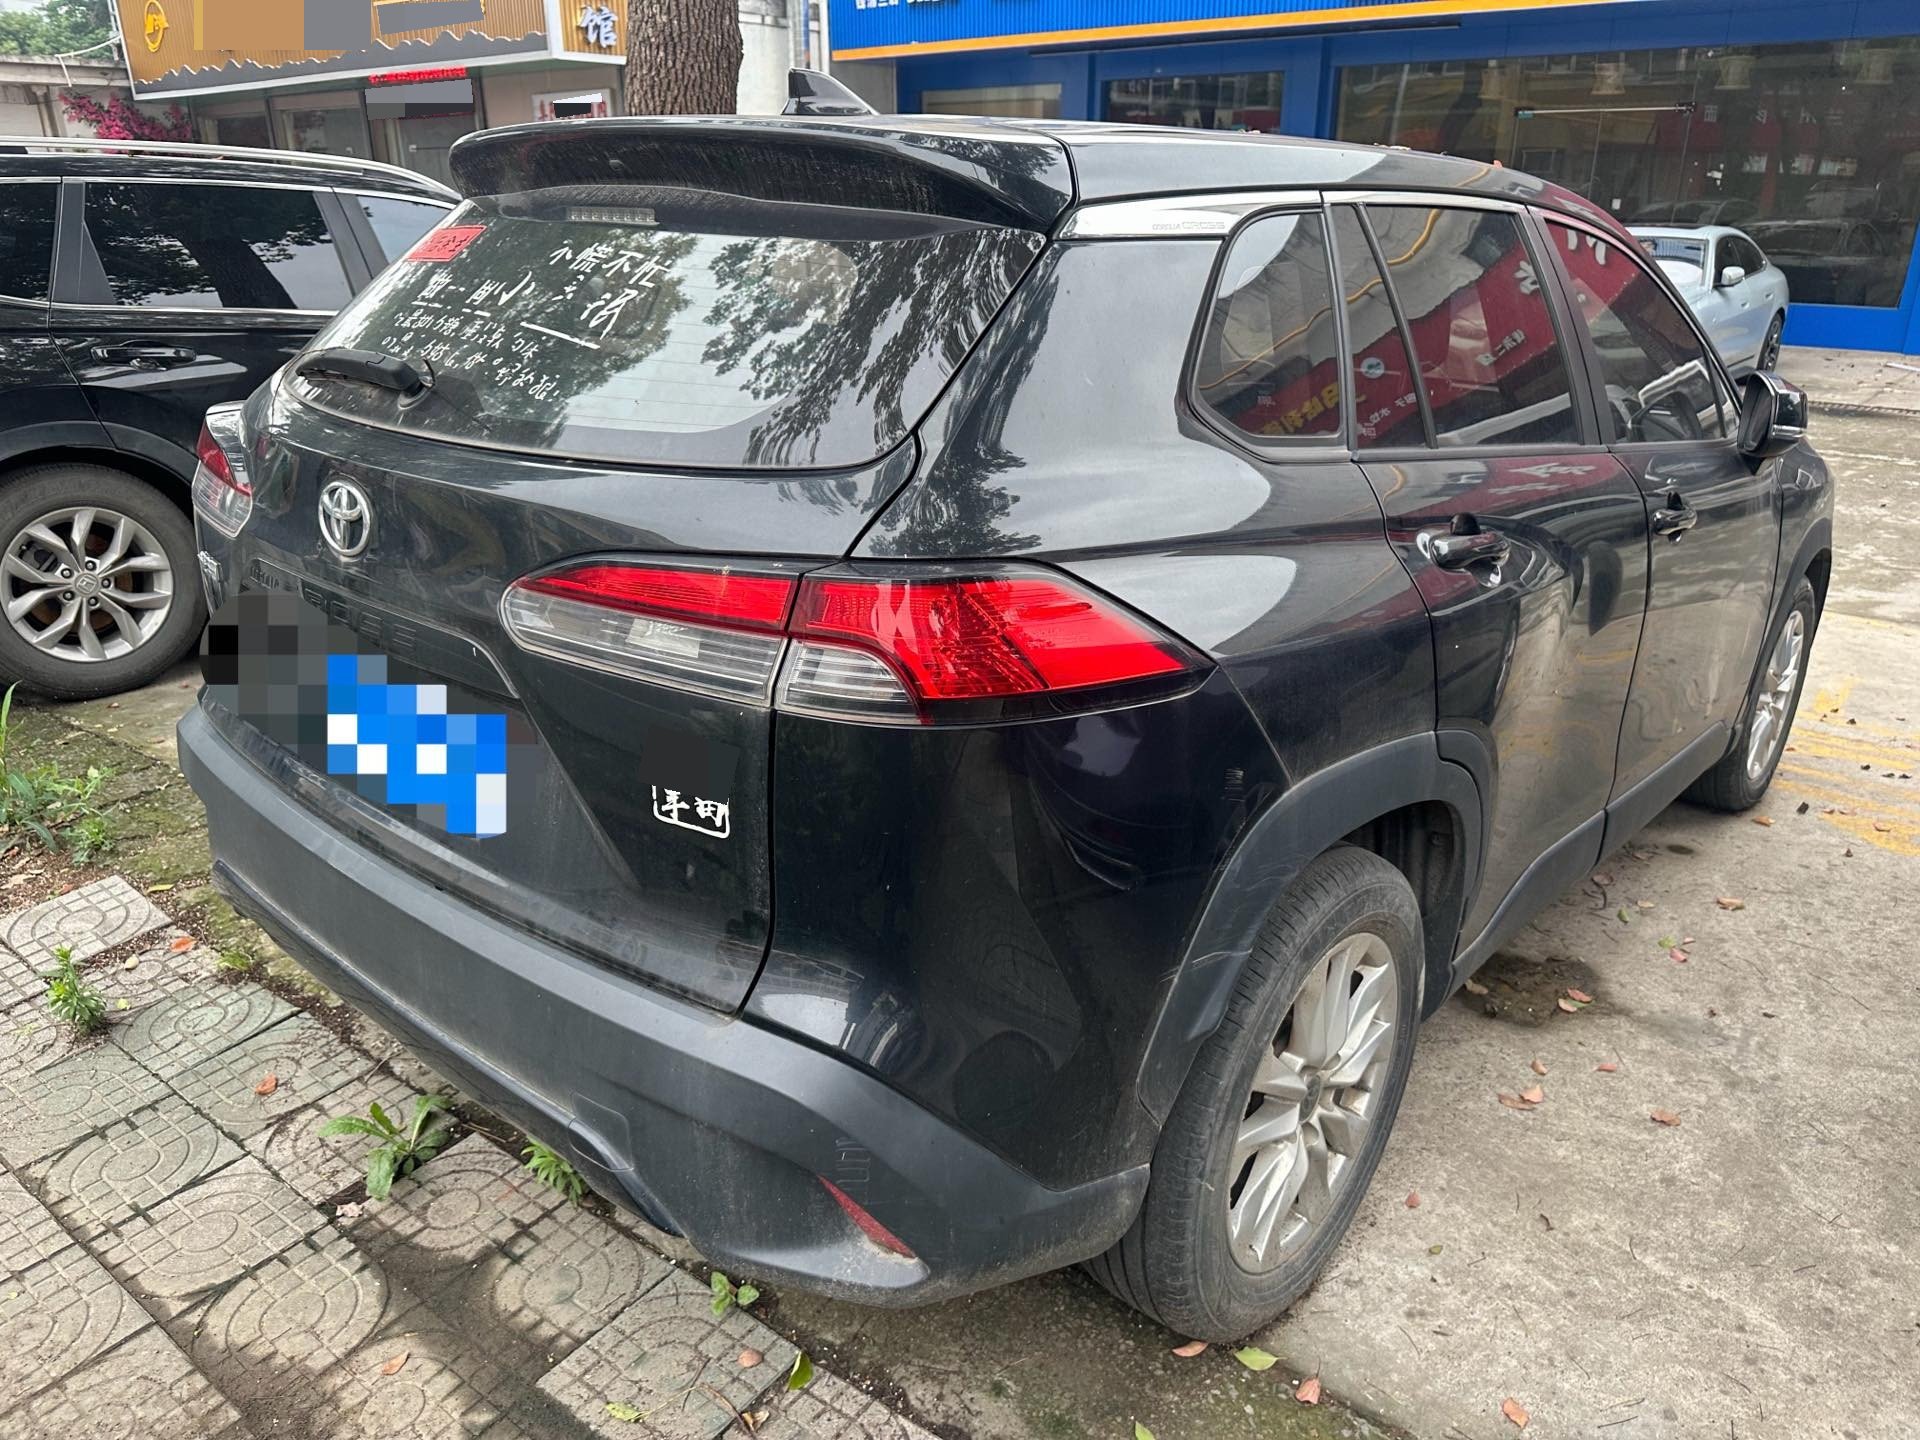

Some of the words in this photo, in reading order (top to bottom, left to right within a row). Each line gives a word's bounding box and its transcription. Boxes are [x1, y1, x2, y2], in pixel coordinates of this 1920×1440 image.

[577, 5, 618, 48] 馆
[550, 240, 671, 288] 不慌不忙
